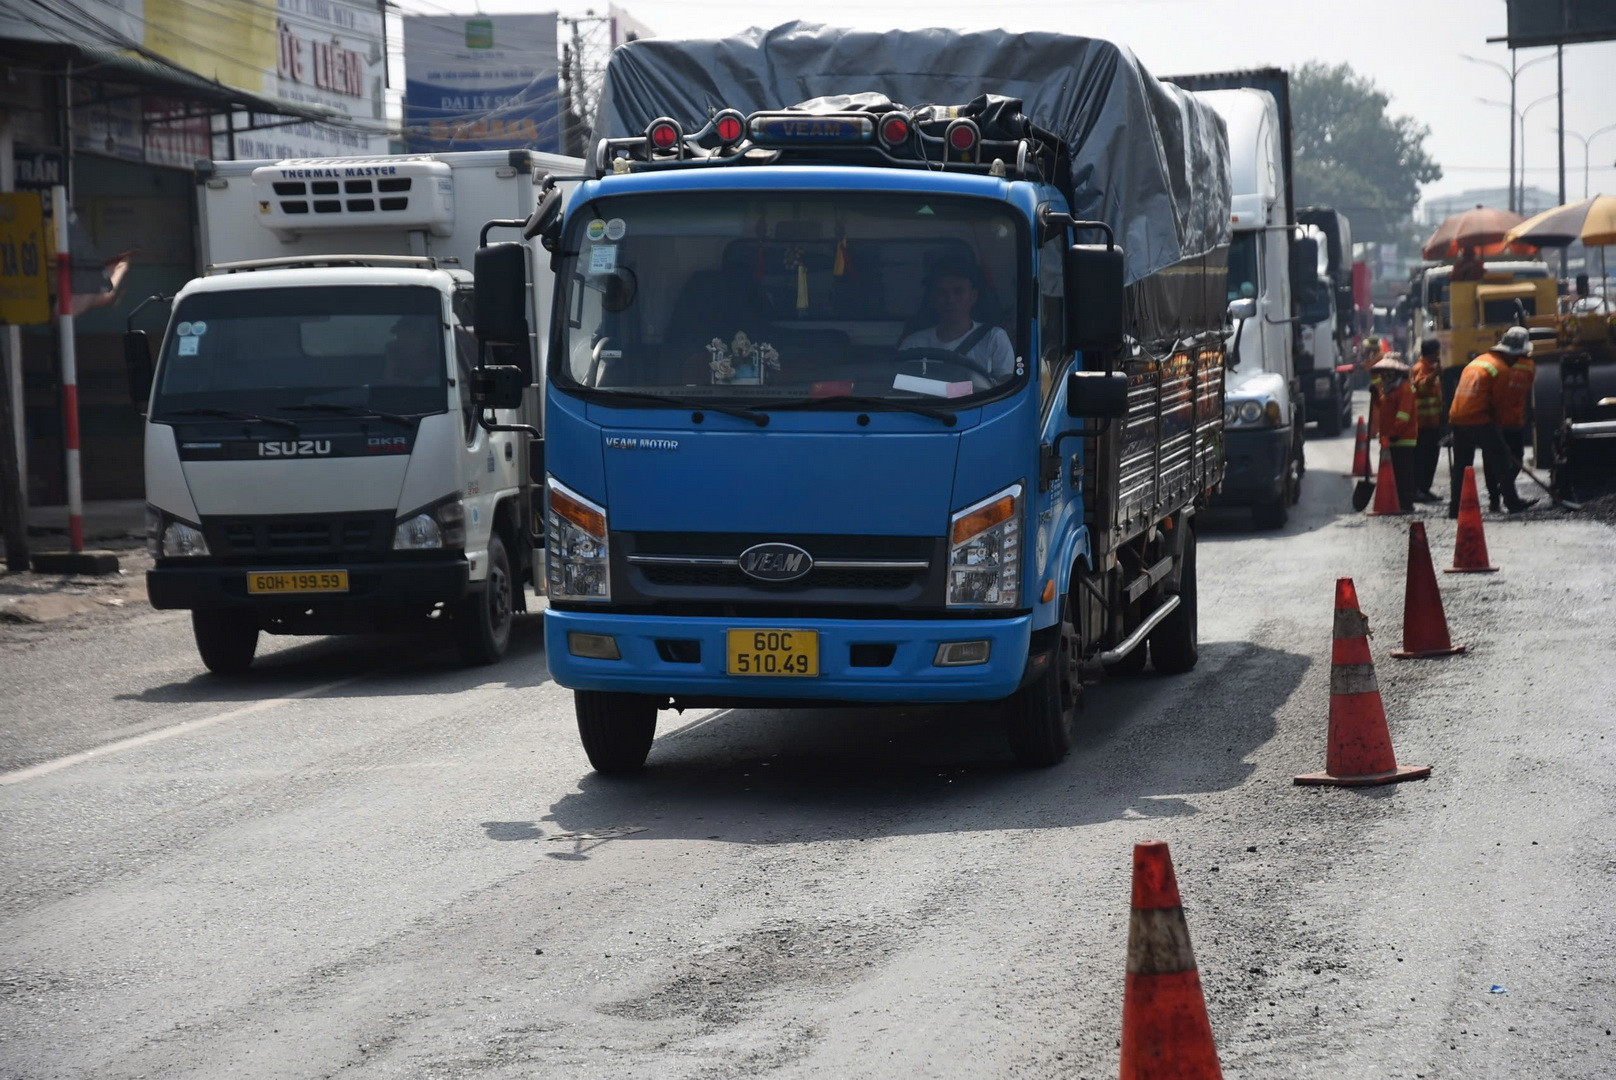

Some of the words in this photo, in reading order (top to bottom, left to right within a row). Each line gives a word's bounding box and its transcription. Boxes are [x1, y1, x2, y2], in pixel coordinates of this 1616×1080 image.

[783, 120, 841, 136] VEAM
[281, 168, 340, 179] THERMAL
[345, 166, 397, 177] MASTER
[258, 440, 331, 456] ISUZU
[605, 437, 637, 448] VEAM
[639, 439, 679, 449] MOTOR
[746, 553, 804, 572] VEAM
[256, 575, 340, 589] 60H-199.59
[754, 632, 793, 651] 60C
[737, 653, 808, 673] 510.49
